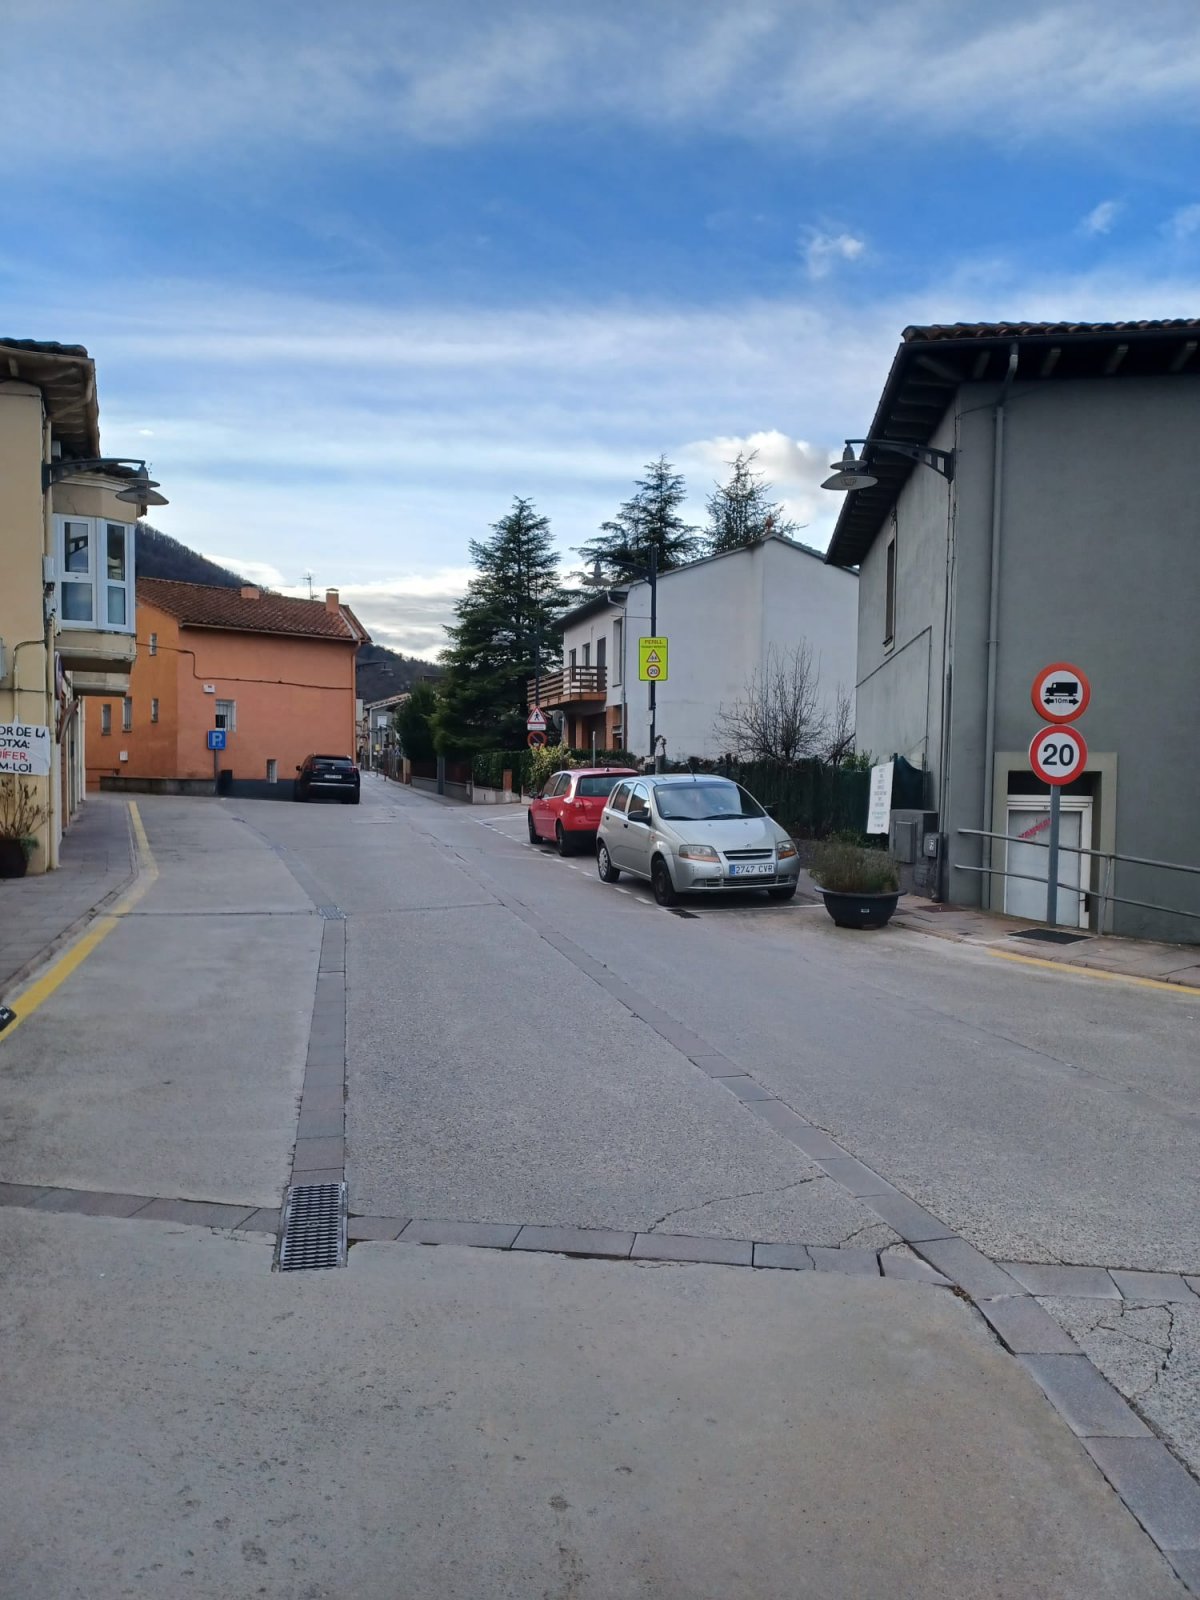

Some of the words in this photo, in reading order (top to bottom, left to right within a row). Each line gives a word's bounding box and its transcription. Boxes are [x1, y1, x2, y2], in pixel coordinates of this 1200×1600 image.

[1054, 697, 1069, 705] 10m
[15, 726, 32, 738] DE
[1042, 743, 1075, 767] 20
[736, 865, 755, 874] 2747
[758, 864, 773, 873] CVR
